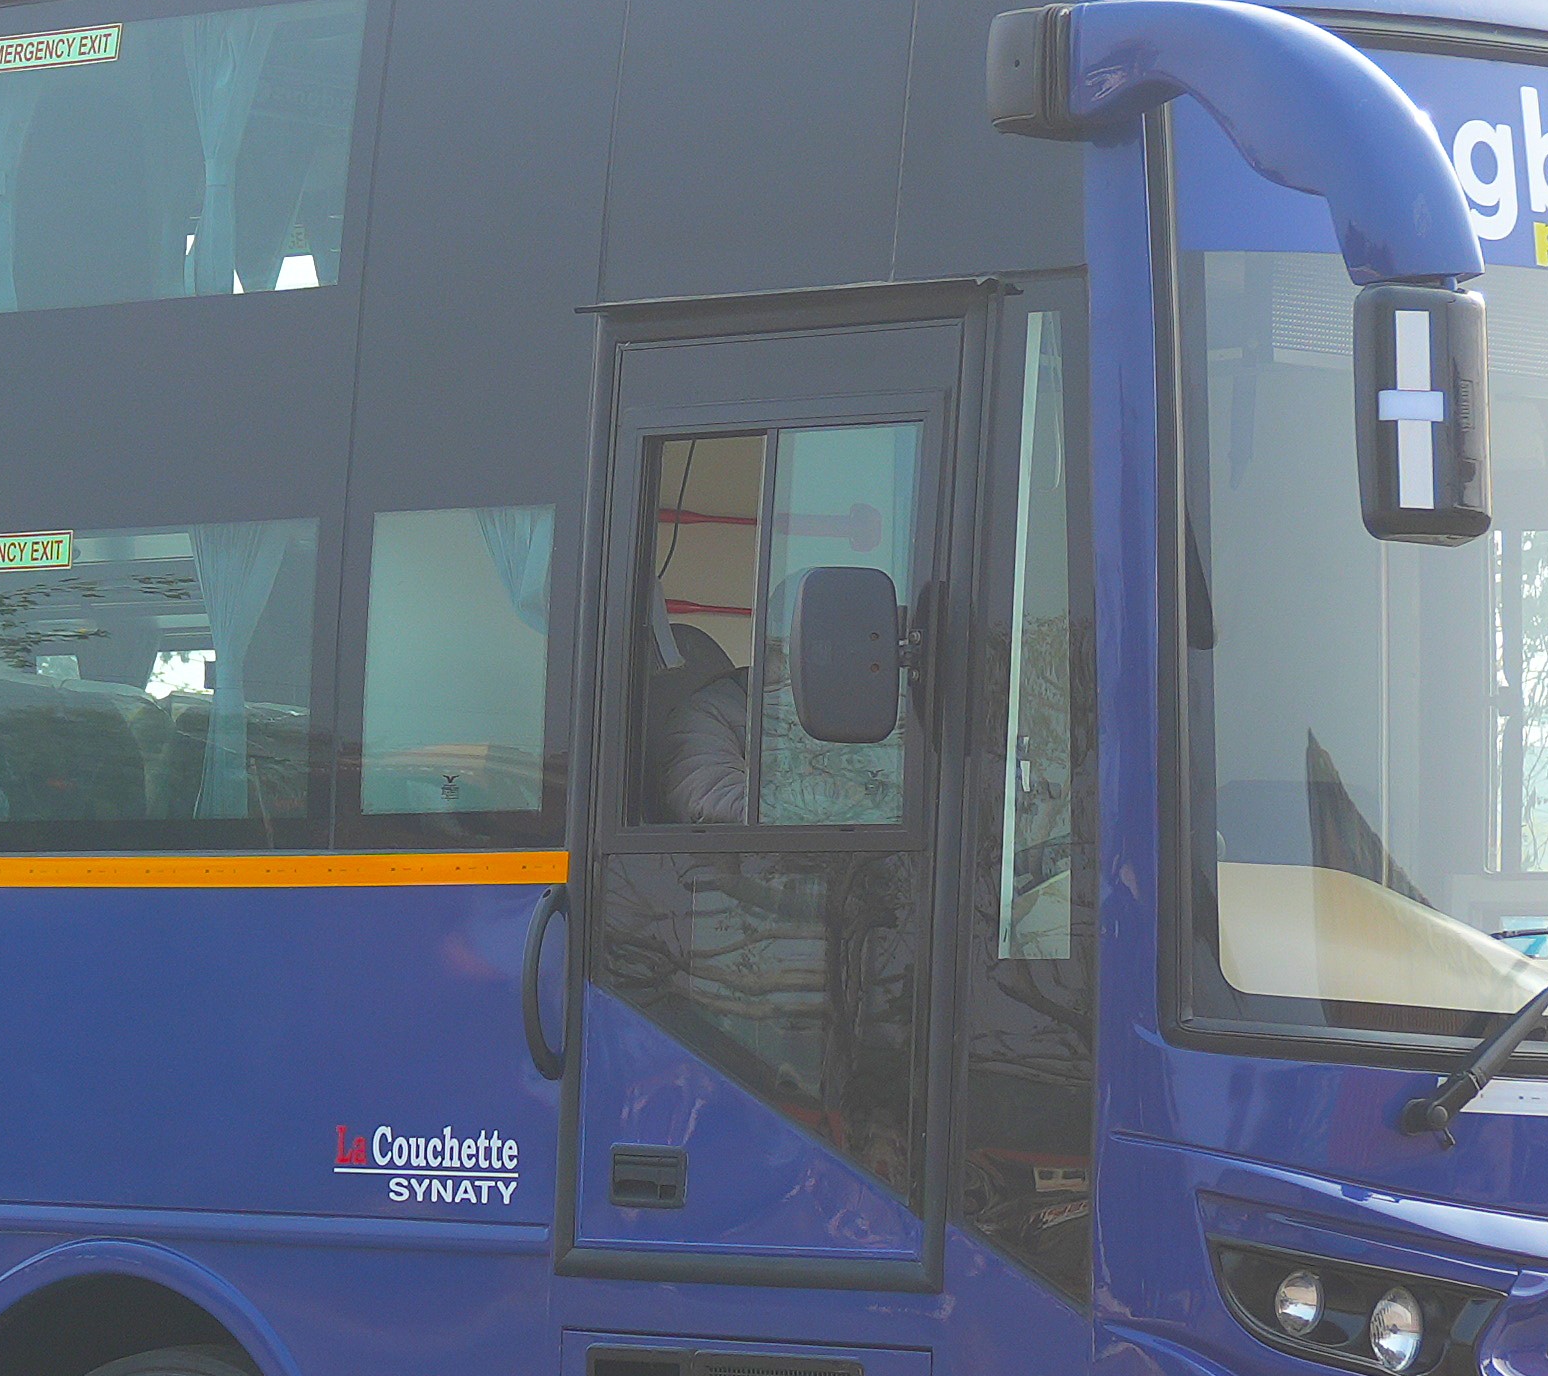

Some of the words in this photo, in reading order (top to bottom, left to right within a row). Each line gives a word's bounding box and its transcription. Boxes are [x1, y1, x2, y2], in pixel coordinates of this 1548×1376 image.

[78, 33, 112, 55] EXIT
[31, 540, 63, 562] EXIT
[335, 1125, 368, 1165] La
[372, 1125, 518, 1170] Couchette
[389, 1177, 517, 1205] SYNATY
